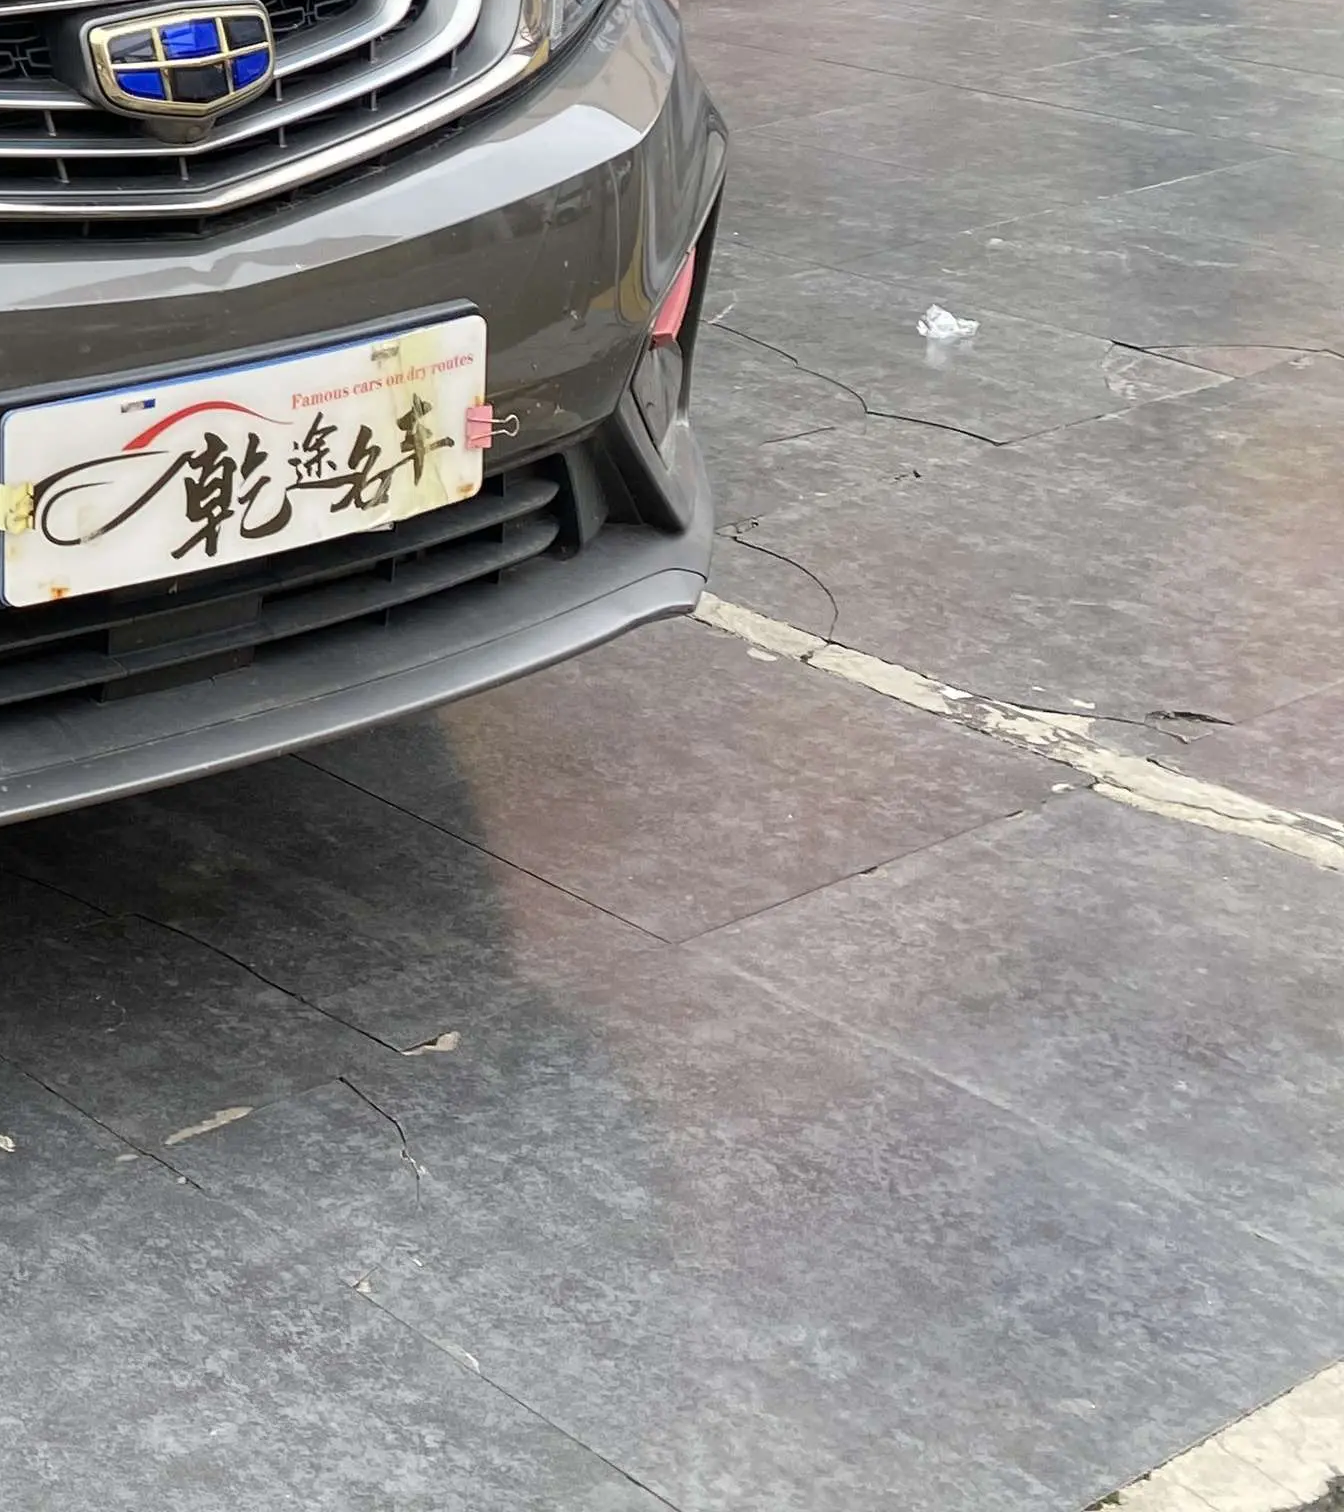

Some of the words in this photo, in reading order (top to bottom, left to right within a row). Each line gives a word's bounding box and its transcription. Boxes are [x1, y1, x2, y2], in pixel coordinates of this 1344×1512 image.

[291, 387, 350, 410] Famous
[353, 378, 383, 395] cars
[386, 372, 404, 386] on
[406, 365, 427, 382] dry
[432, 353, 474, 375] routes
[171, 392, 456, 560] 乾途名车
